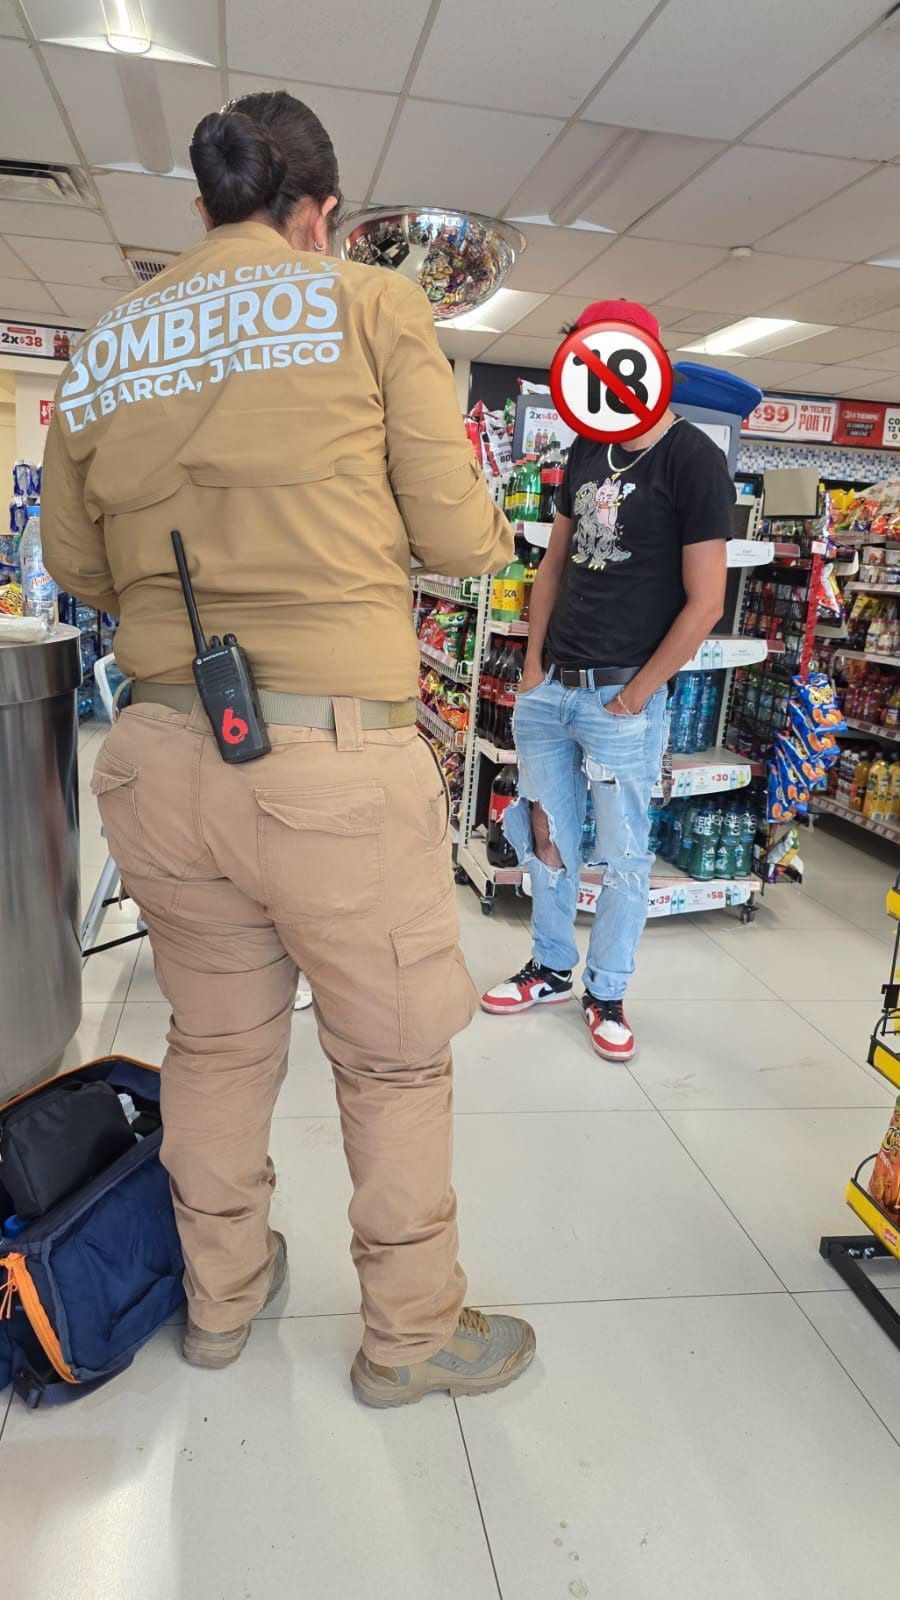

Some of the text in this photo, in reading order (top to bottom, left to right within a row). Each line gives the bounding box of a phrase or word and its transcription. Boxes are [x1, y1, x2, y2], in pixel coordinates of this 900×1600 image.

[97, 269, 226, 326] OTECCIÓN
[234, 262, 310, 283] CIVIL
[65, 342, 340, 433] LA BARCA, JALISCO
[222, 708, 249, 744] 6
